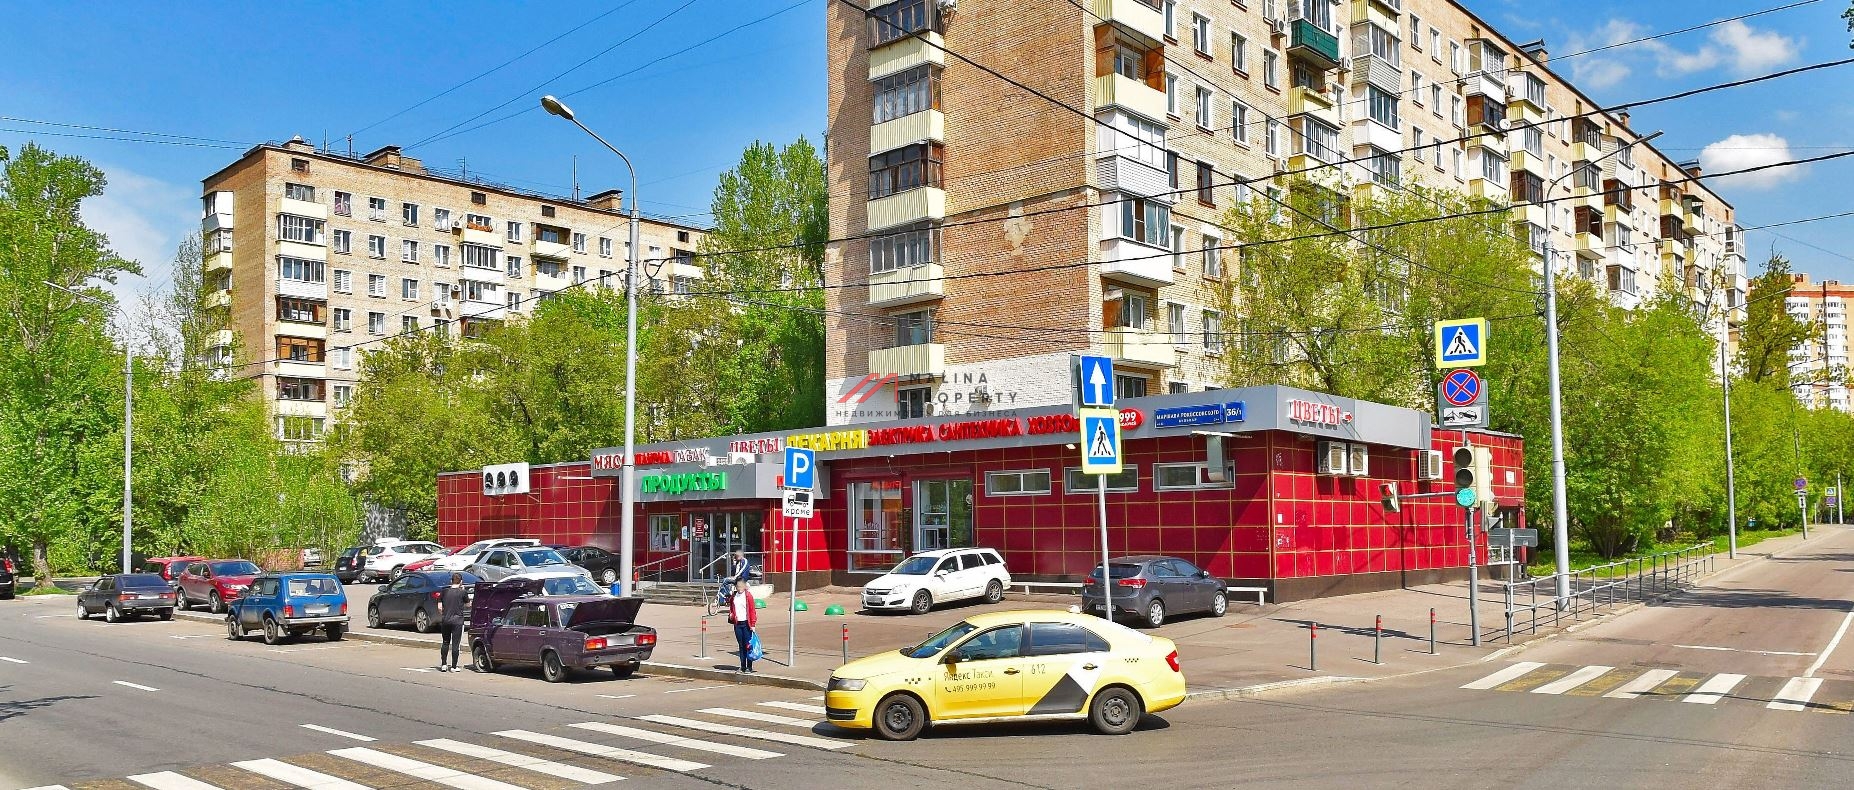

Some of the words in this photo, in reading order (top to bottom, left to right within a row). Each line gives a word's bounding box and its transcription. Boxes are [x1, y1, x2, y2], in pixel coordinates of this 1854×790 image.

[1291, 399, 1342, 425] ЦВЕТЫ
[594, 453, 625, 470] МЯС
[674, 448, 710, 463] ТАБАК
[786, 429, 866, 452] ПЕКАРНЯ
[792, 452, 810, 484] P
[642, 471, 726, 495] ПРОДУКТЫ
[785, 507, 811, 516] кроме
[944, 671, 971, 682] Яндекс
[972, 668, 993, 679] Такси
[1031, 663, 1046, 675] 612
